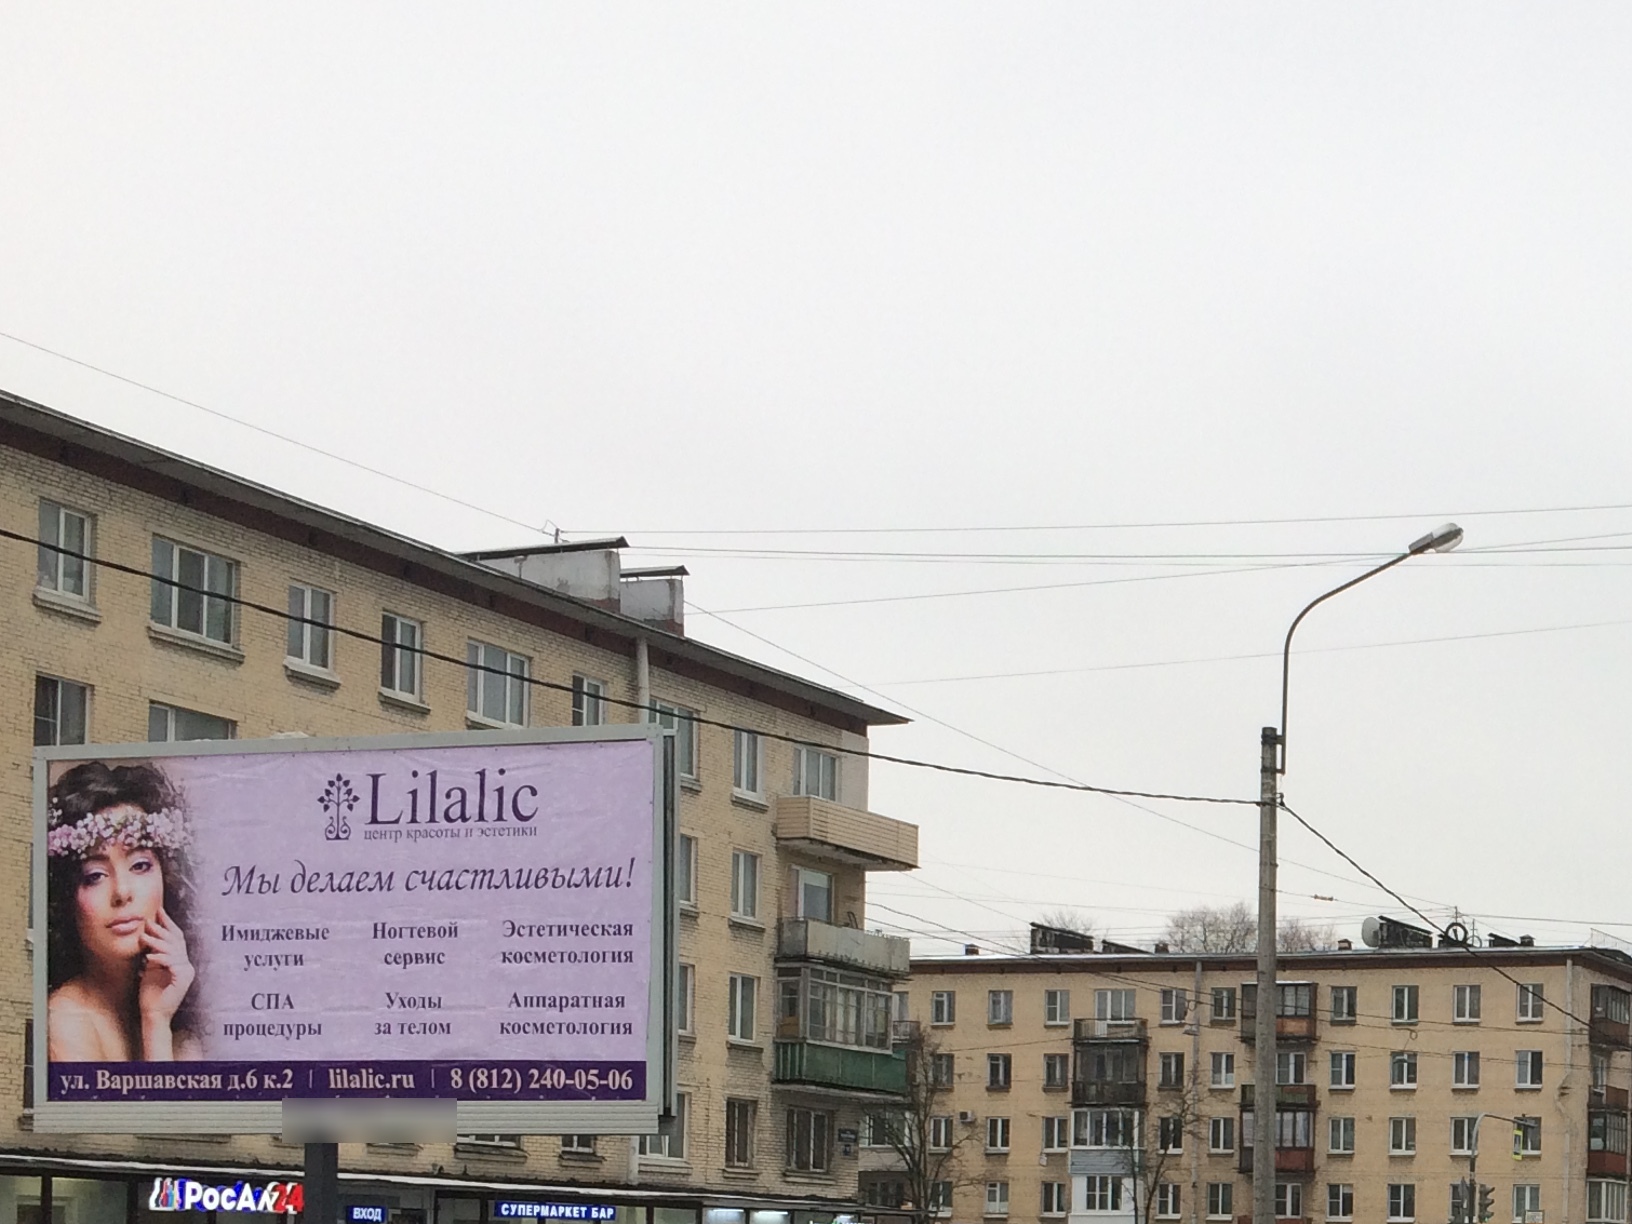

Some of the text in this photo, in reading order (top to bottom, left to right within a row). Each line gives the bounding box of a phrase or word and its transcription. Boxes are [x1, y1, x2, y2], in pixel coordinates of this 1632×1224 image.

[365, 768, 539, 826] Lilalic
[364, 826, 538, 843] центр красоты и эстетики
[222, 857, 637, 896] Мы делаем счастливыми!
[221, 923, 330, 943] Имиджевые
[372, 921, 459, 940] Ногтевой
[502, 919, 634, 938] Эстетическая
[243, 951, 305, 972] услуги
[384, 950, 446, 970] сервис
[501, 947, 634, 965] косметология
[250, 992, 295, 1011] СПА
[385, 992, 443, 1011] Уходы
[508, 992, 626, 1012] Аппаратная
[223, 1020, 323, 1041] процедуры
[374, 1020, 452, 1036] за телом
[499, 1019, 633, 1036] косметология
[60, 1068, 294, 1096] ул. Варшавская д.6 к.2
[328, 1068, 415, 1089] lilalic.ru
[450, 1068, 634, 1094] 8 (812) 240-05-06
[352, 1207, 382, 1222] ВХОД
[501, 1203, 614, 1219] СУПЕРМАРКЕТ БАР
